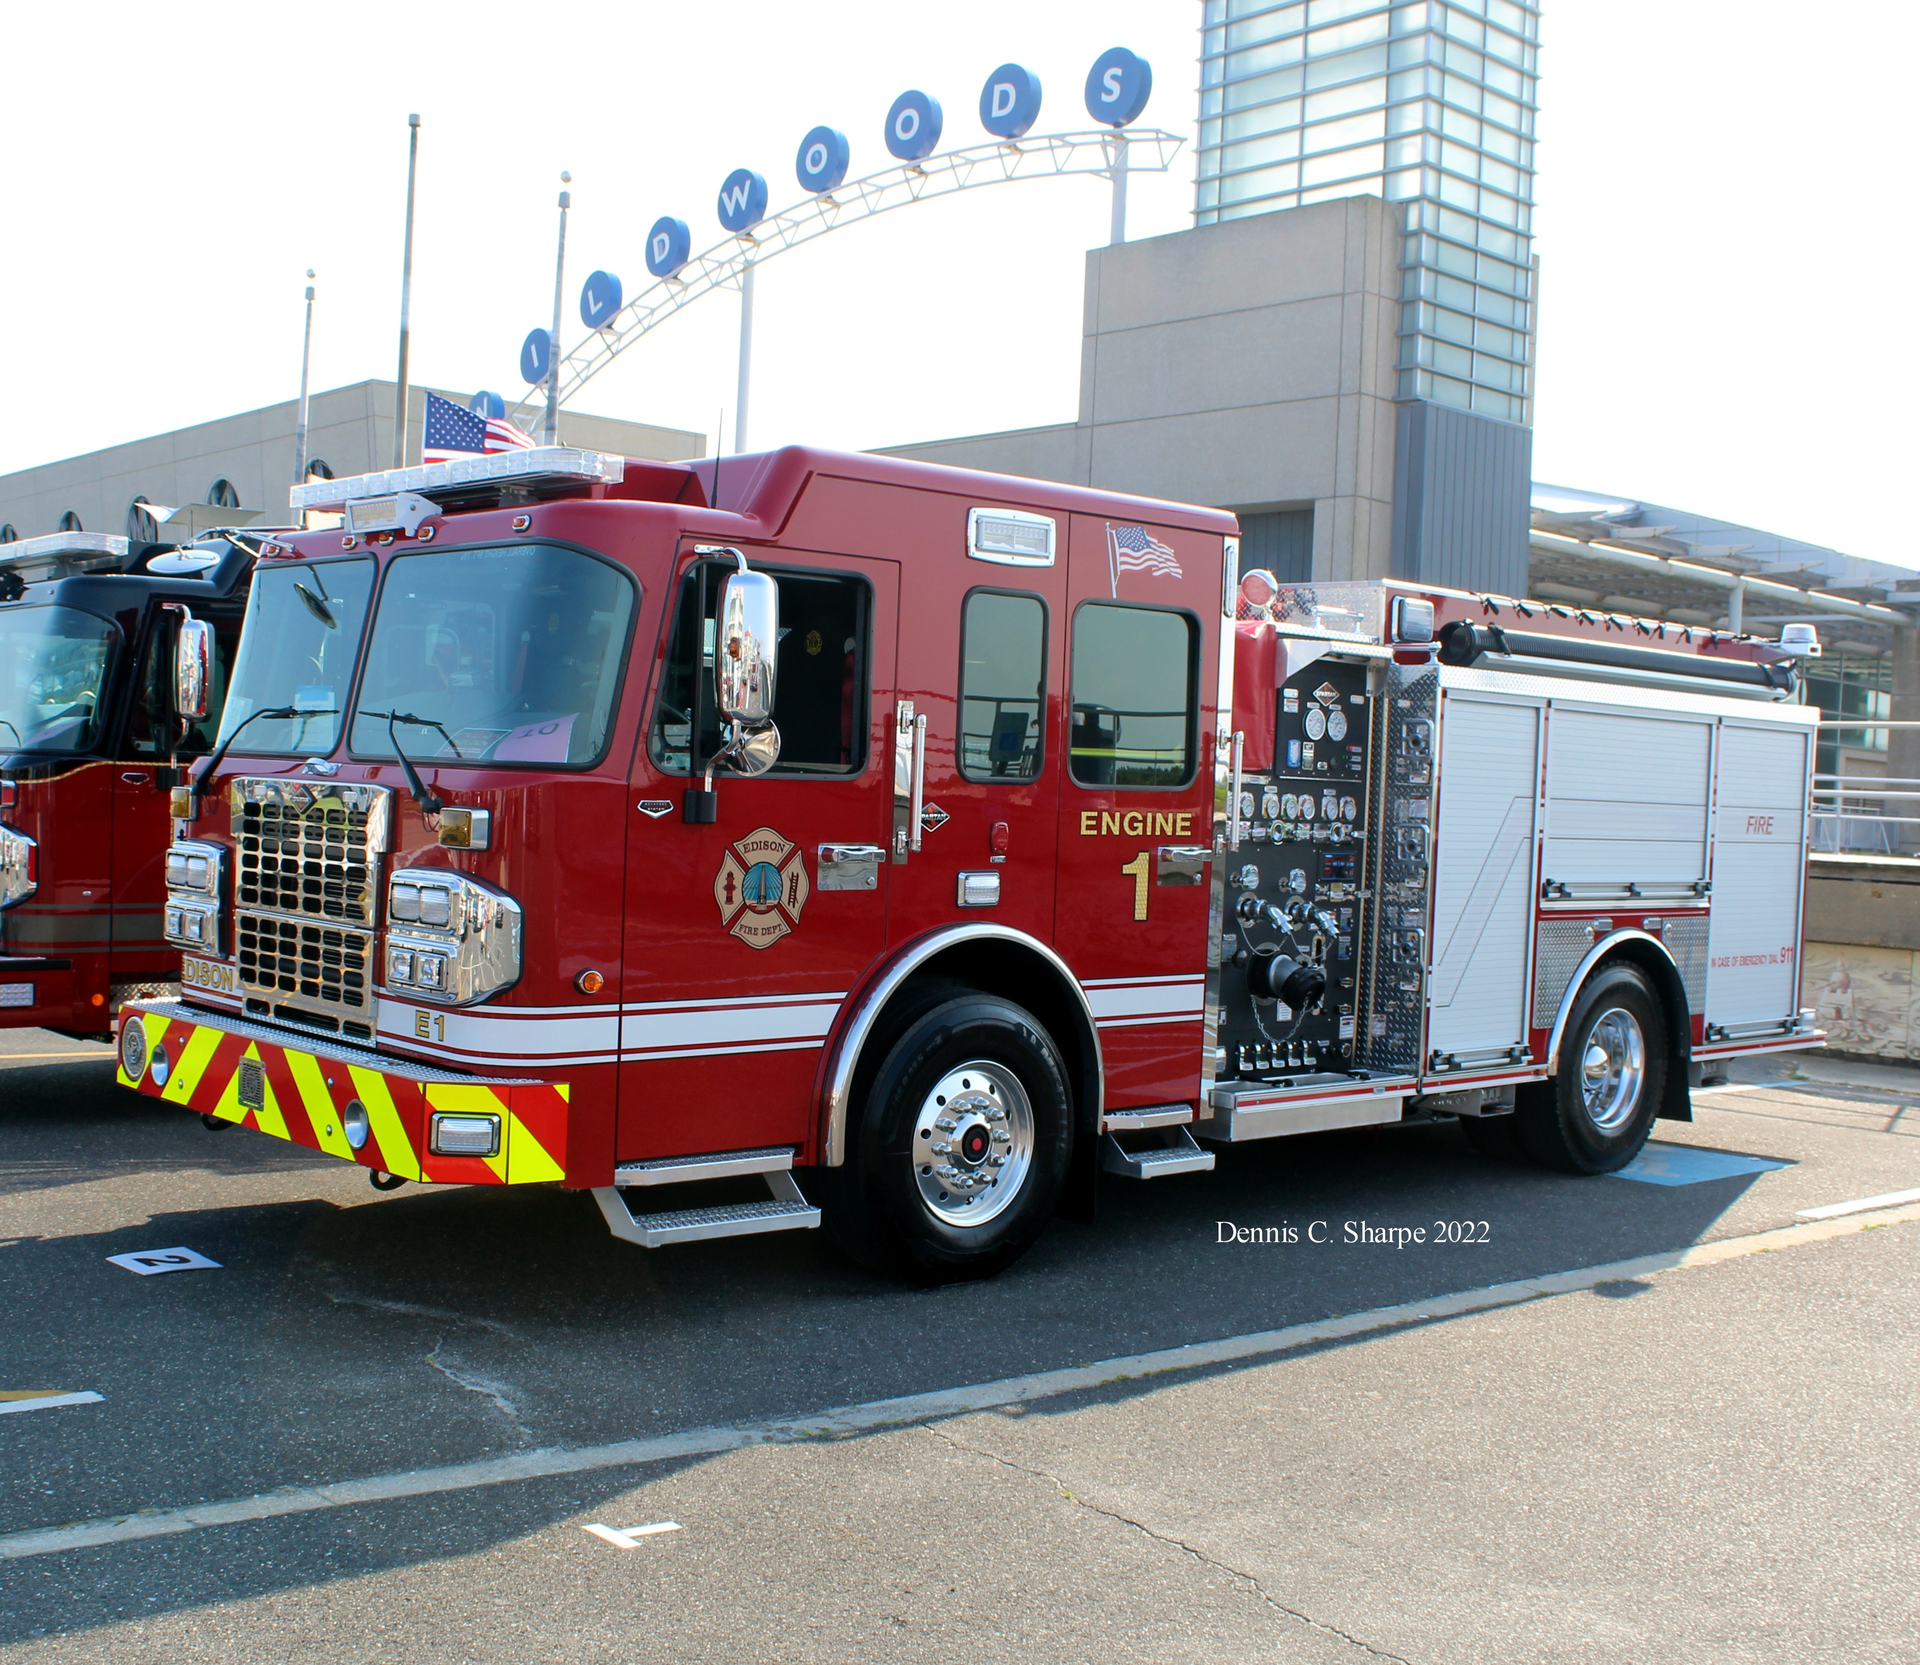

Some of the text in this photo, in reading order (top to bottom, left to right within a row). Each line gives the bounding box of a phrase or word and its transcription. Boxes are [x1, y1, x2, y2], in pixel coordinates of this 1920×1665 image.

[1080, 811, 1192, 836] ENGINE
[1746, 816, 1774, 835] FIRE
[742, 840, 786, 855] EDISON
[1122, 851, 1150, 922] 1
[738, 924, 759, 937] FIRE
[1711, 946, 1795, 968] IN CASE OF EMERGENCY DIAL 911
[415, 1010, 445, 1042] E1
